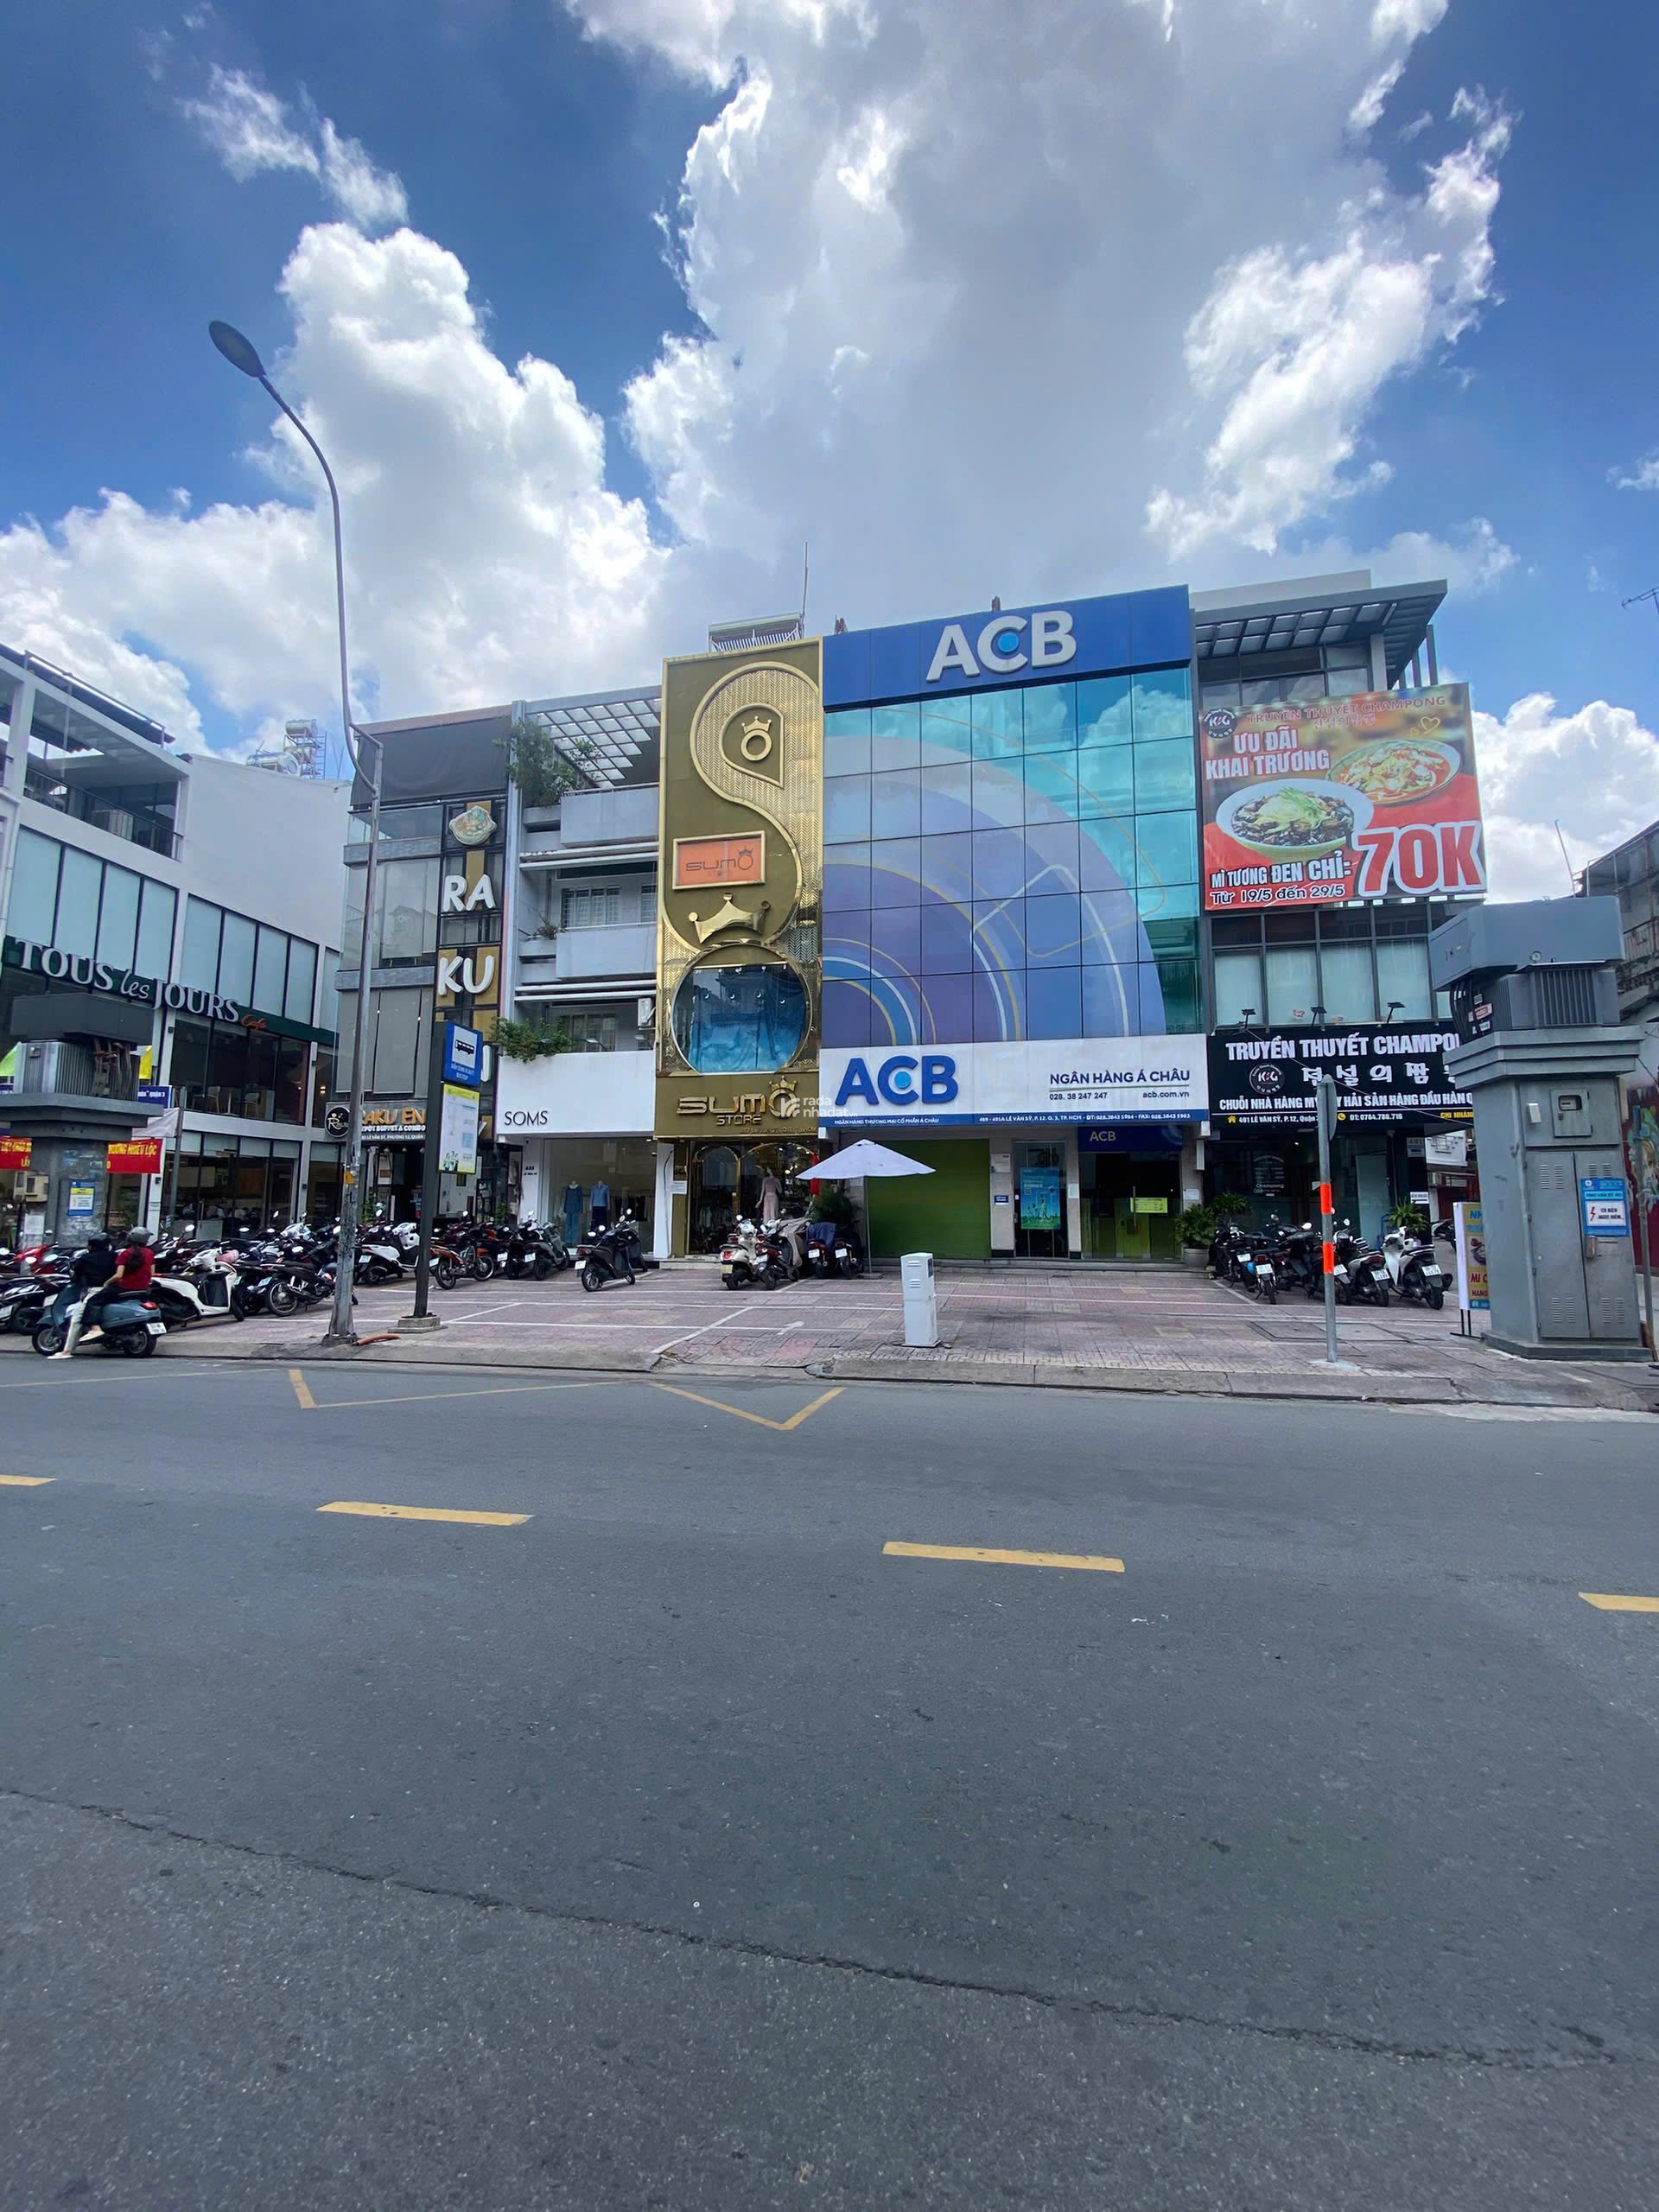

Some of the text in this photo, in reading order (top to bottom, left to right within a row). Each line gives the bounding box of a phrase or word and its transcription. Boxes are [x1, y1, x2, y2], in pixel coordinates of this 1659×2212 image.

[926, 610, 1077, 683] ACB
[1362, 696, 1446, 714] CHAMPONG
[1234, 726, 1297, 754] ƯU ĐÃI
[1205, 749, 1330, 779] KHAI TRƯƠNG
[1211, 850, 1352, 888] MÌ TƯƠNG ĐEN CHỈ:
[1357, 824, 1484, 893] 70K
[443, 874, 496, 912] RA
[1211, 884, 1345, 904] Từ 19/5 đến 29/5
[15, 938, 240, 1024] TOUS les JOURS
[437, 955, 495, 996] KU
[1300, 1032, 1370, 1058] THUYẾT
[1374, 1033, 1459, 1056] CHAMPO
[835, 1055, 959, 1106] ACB
[1050, 1068, 1190, 1085] NGÂN HÀNG Á CHÂU
[1142, 1090, 1190, 1099] acb.com.vn
[1251, 1096, 1271, 1109] NHÀ
[1274, 1096, 1302, 1109] HÀNG
[1344, 1092, 1362, 1107] HẢI
[1363, 1092, 1388, 1107] SẢN
[1389, 1090, 1418, 1106] HÀNG
[1442, 1090, 1466, 1104] HÀN
[401, 1107, 427, 1124] EN
[505, 1110, 549, 1126] SOMS
[716, 1114, 762, 1126] STORE
[1090, 1130, 1116, 1141] ACB
